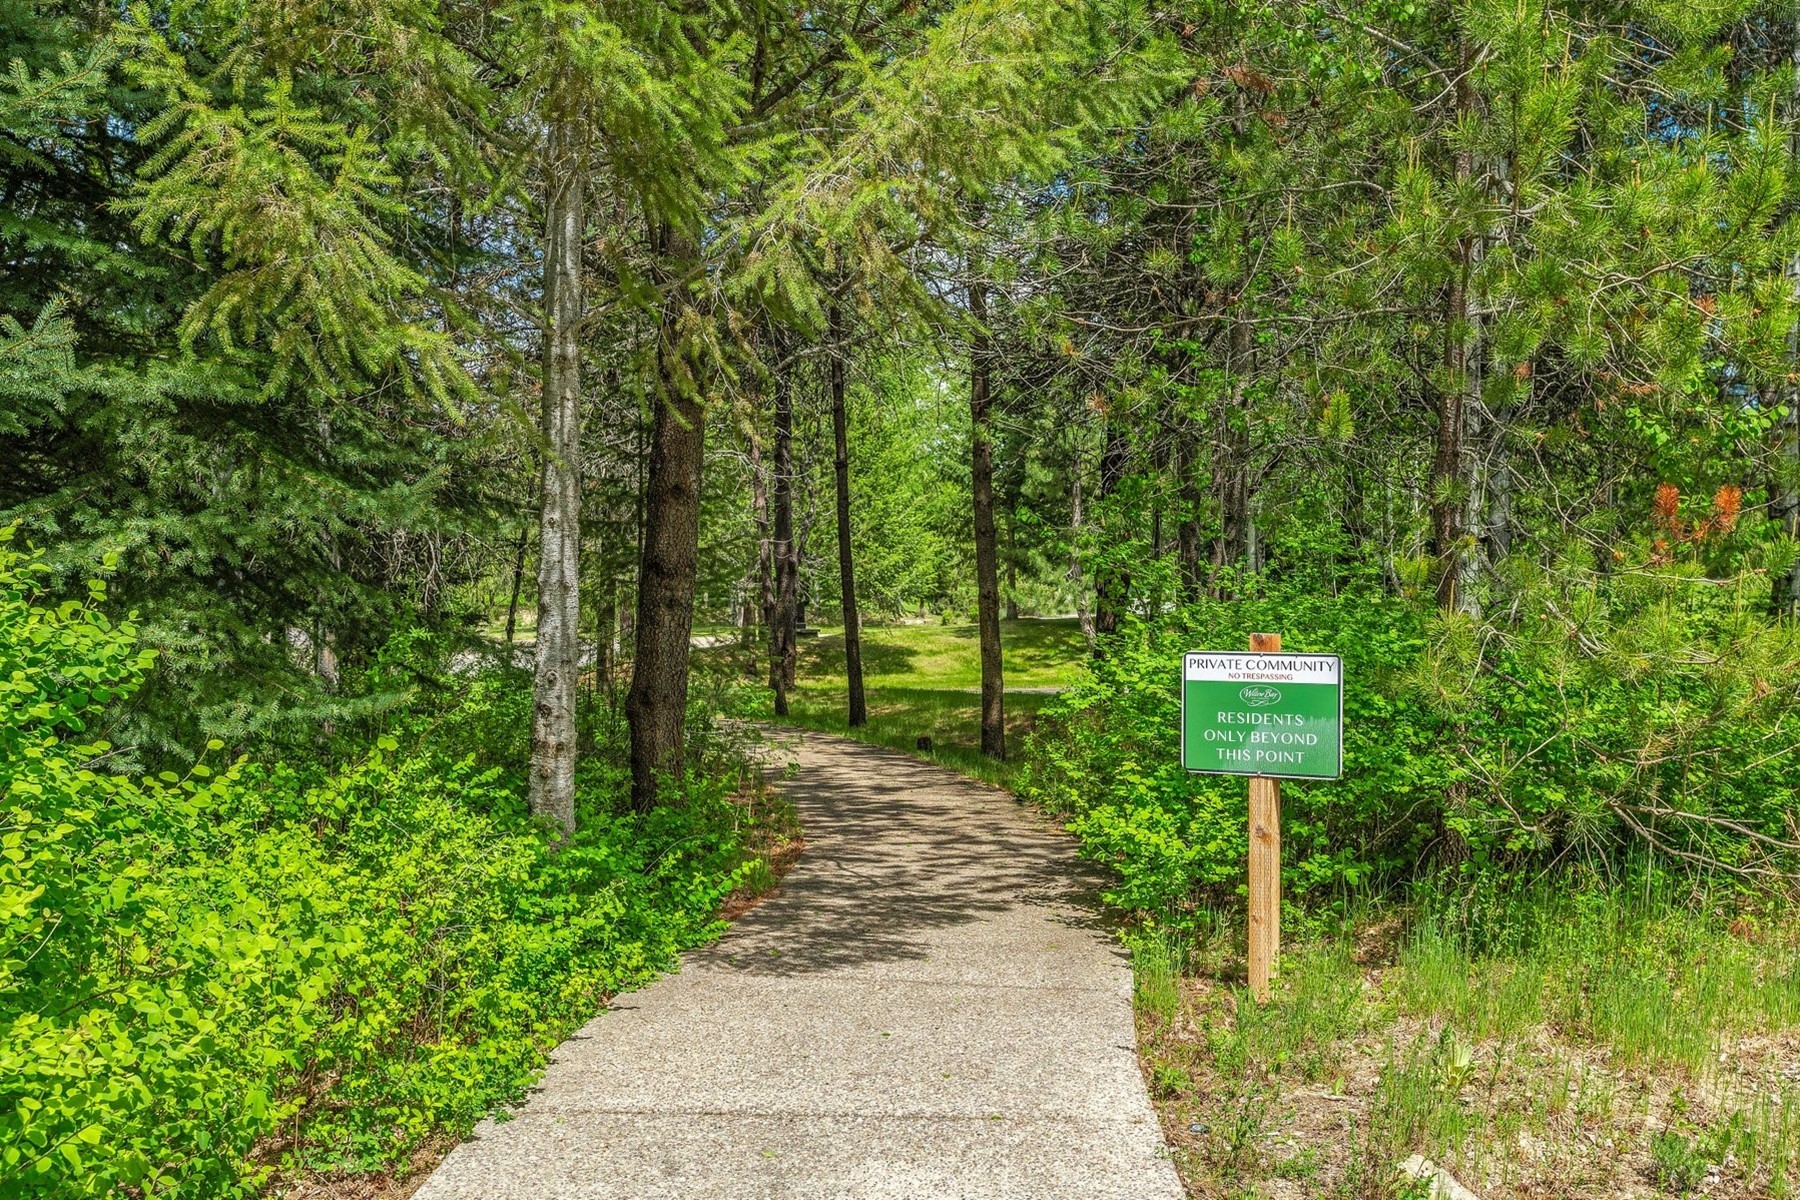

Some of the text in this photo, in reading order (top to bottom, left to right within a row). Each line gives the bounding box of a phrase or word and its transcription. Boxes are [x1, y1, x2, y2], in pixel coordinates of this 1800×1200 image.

[1189, 658, 1335, 671] PRIVATE COMMUNITY
[1218, 712, 1303, 726] RESIDENTS
[1204, 730, 1317, 745] ONLY BEYOND
[1216, 748, 1304, 763] THIS POINT
